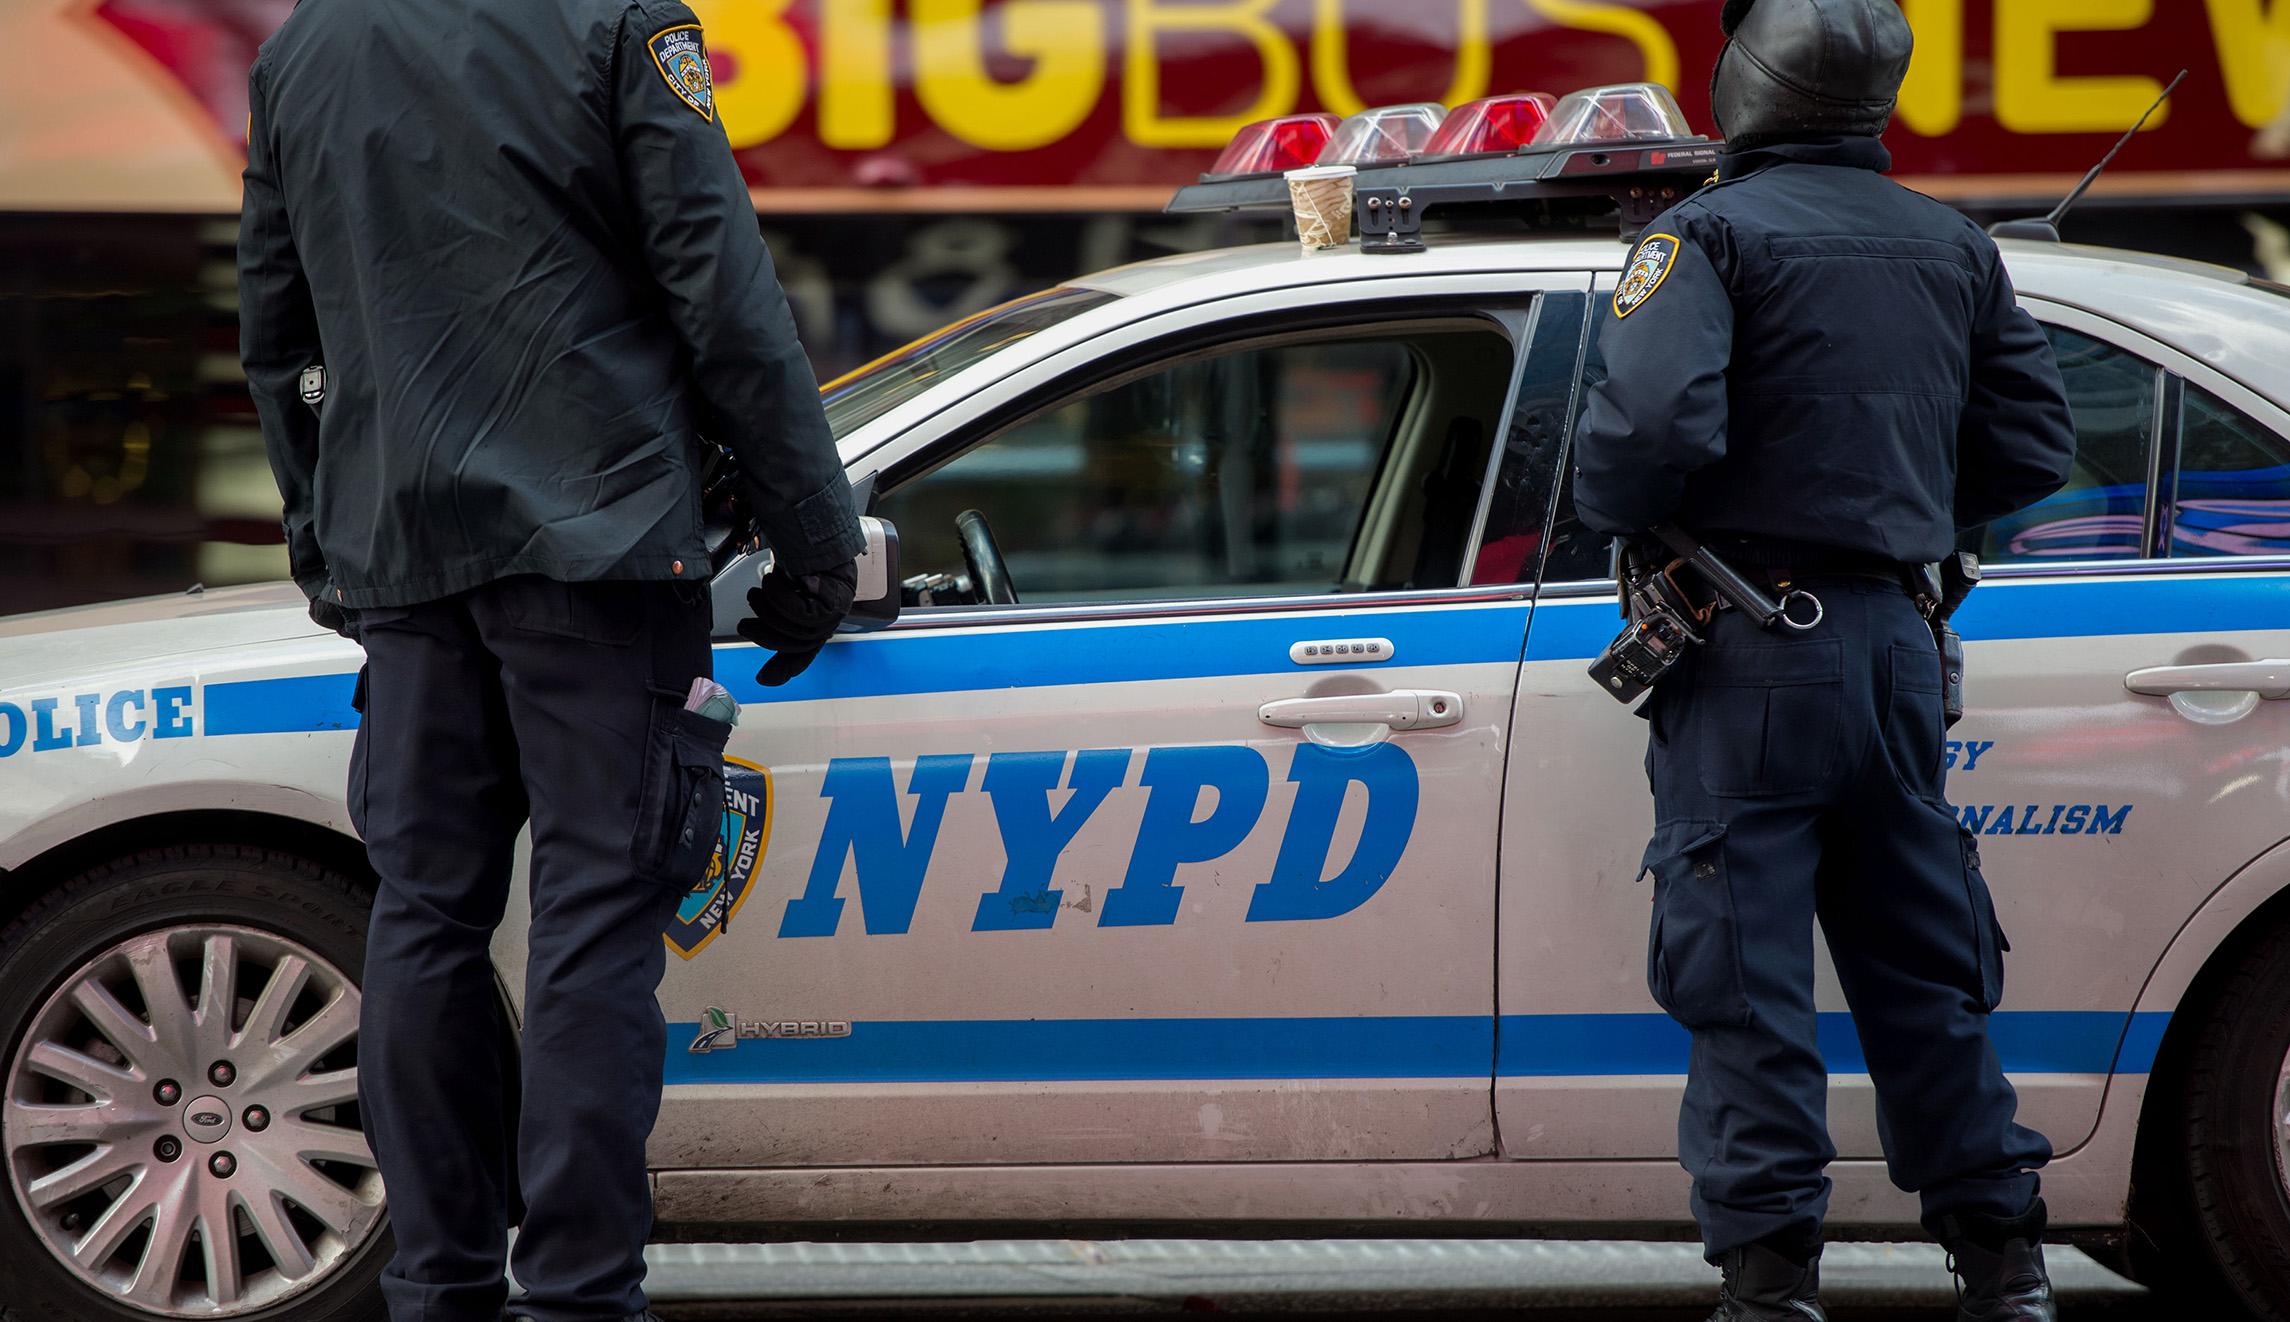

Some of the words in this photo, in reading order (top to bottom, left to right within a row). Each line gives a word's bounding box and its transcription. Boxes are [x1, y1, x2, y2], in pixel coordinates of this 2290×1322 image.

[664, 31, 690, 46] POLICE
[659, 41, 700, 63] DEPARTMENT
[667, 73, 687, 95] CITY
[1645, 267, 1664, 289] YORK
[1952, 805, 2133, 835] NALISM
[778, 742, 1419, 938] NYPD
[699, 888, 734, 930] NEW
[730, 829, 760, 880] YORK
[110, 879, 239, 913] EAGLE
[740, 1021, 848, 1036] HYBRID
